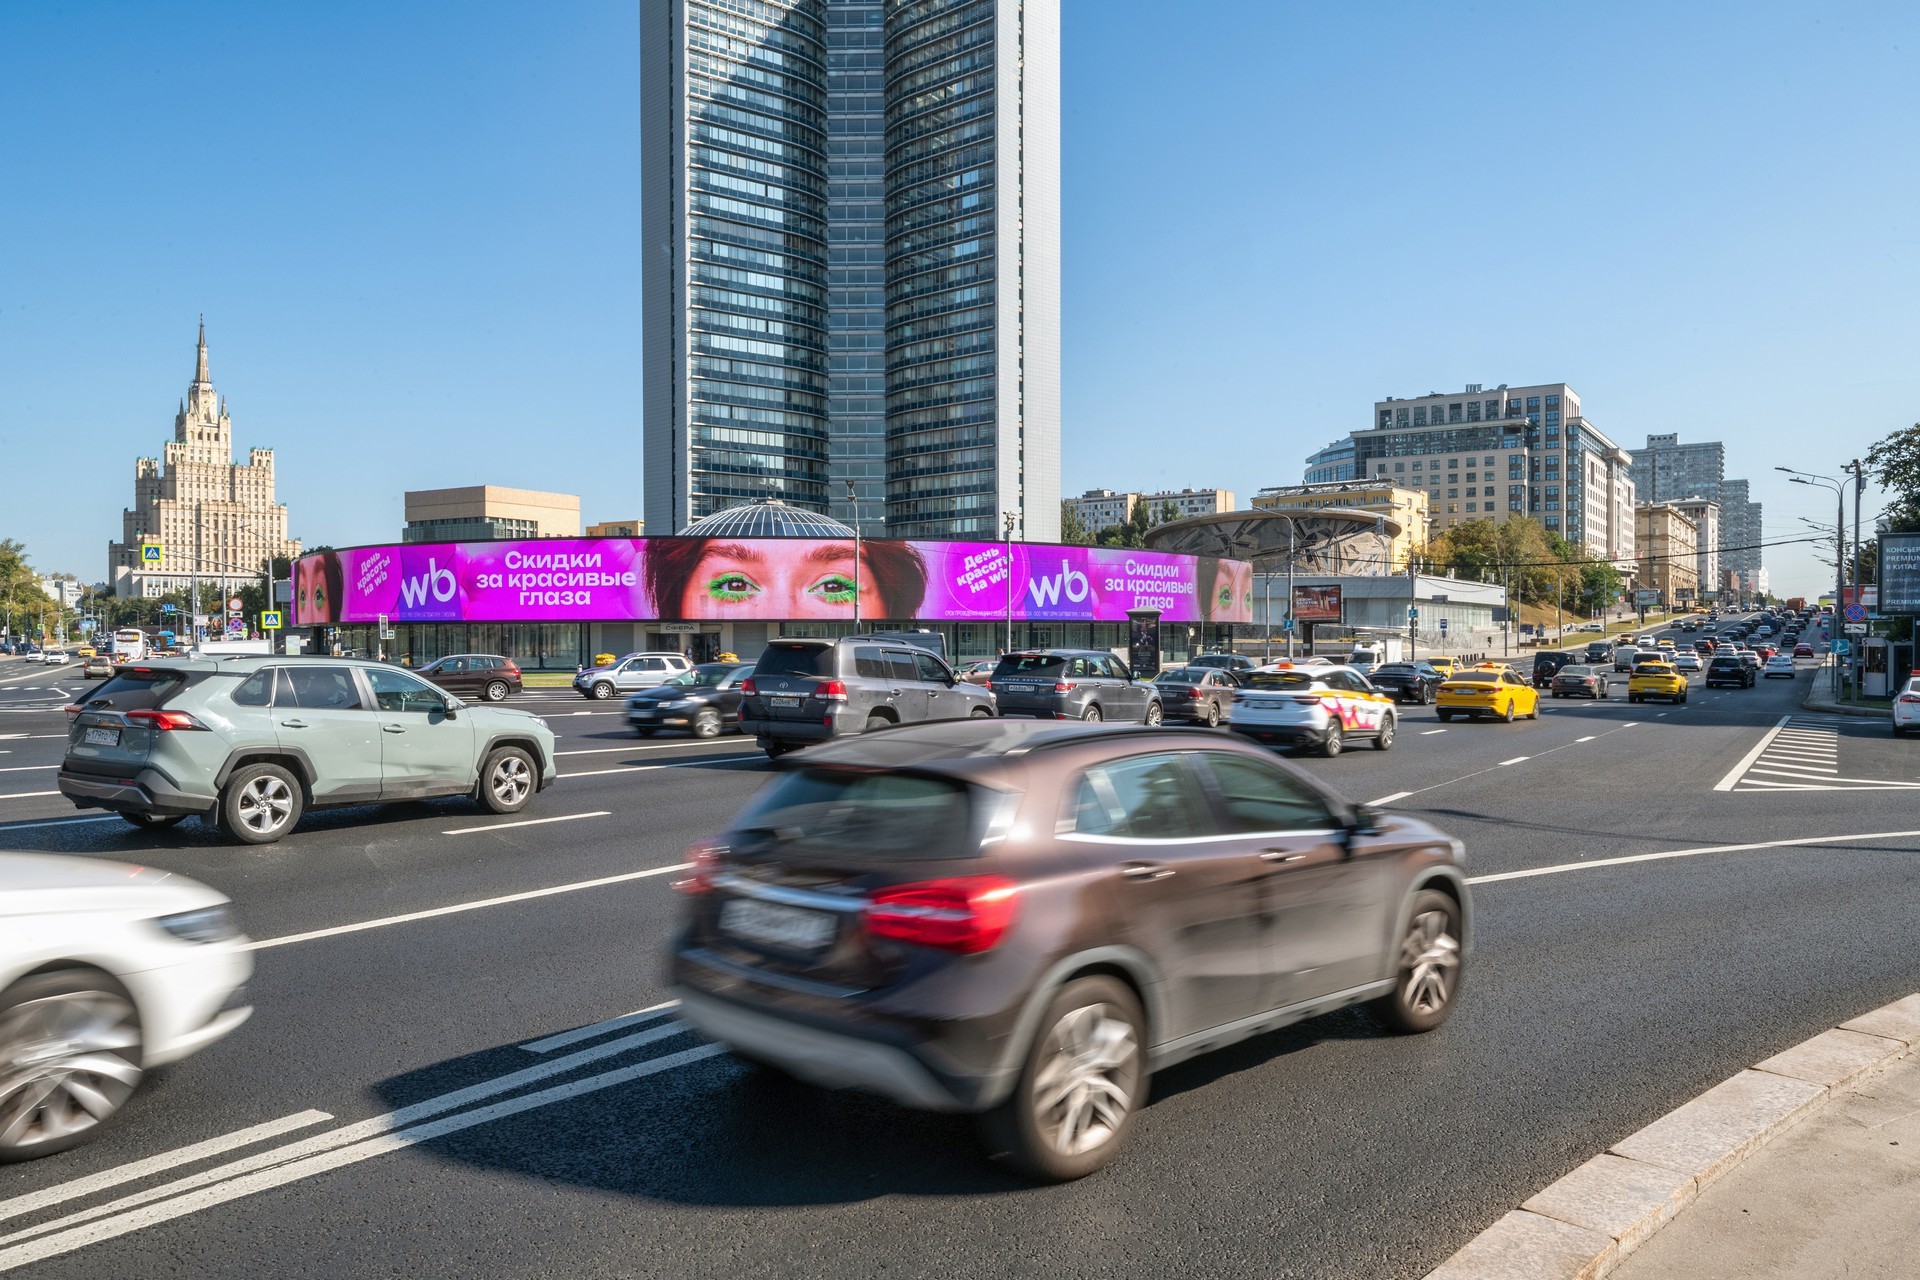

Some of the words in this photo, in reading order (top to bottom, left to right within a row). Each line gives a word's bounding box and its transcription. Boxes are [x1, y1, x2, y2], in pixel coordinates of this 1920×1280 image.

[360, 552, 381, 576] День
[504, 550, 602, 571] Скидки
[963, 548, 1000, 571] День
[1125, 558, 1179, 579] Скидки
[356, 555, 391, 590] красоты
[401, 557, 457, 609] wb
[476, 573, 503, 588] за
[508, 571, 637, 591] красивые
[363, 583, 374, 597] на
[373, 570, 388, 586] wb
[969, 579, 988, 594] на
[1028, 559, 1089, 608] wb
[1104, 577, 1124, 592] за
[1127, 578, 1194, 596] красивые
[519, 590, 591, 606] глаза
[1134, 595, 1175, 610] глаза
